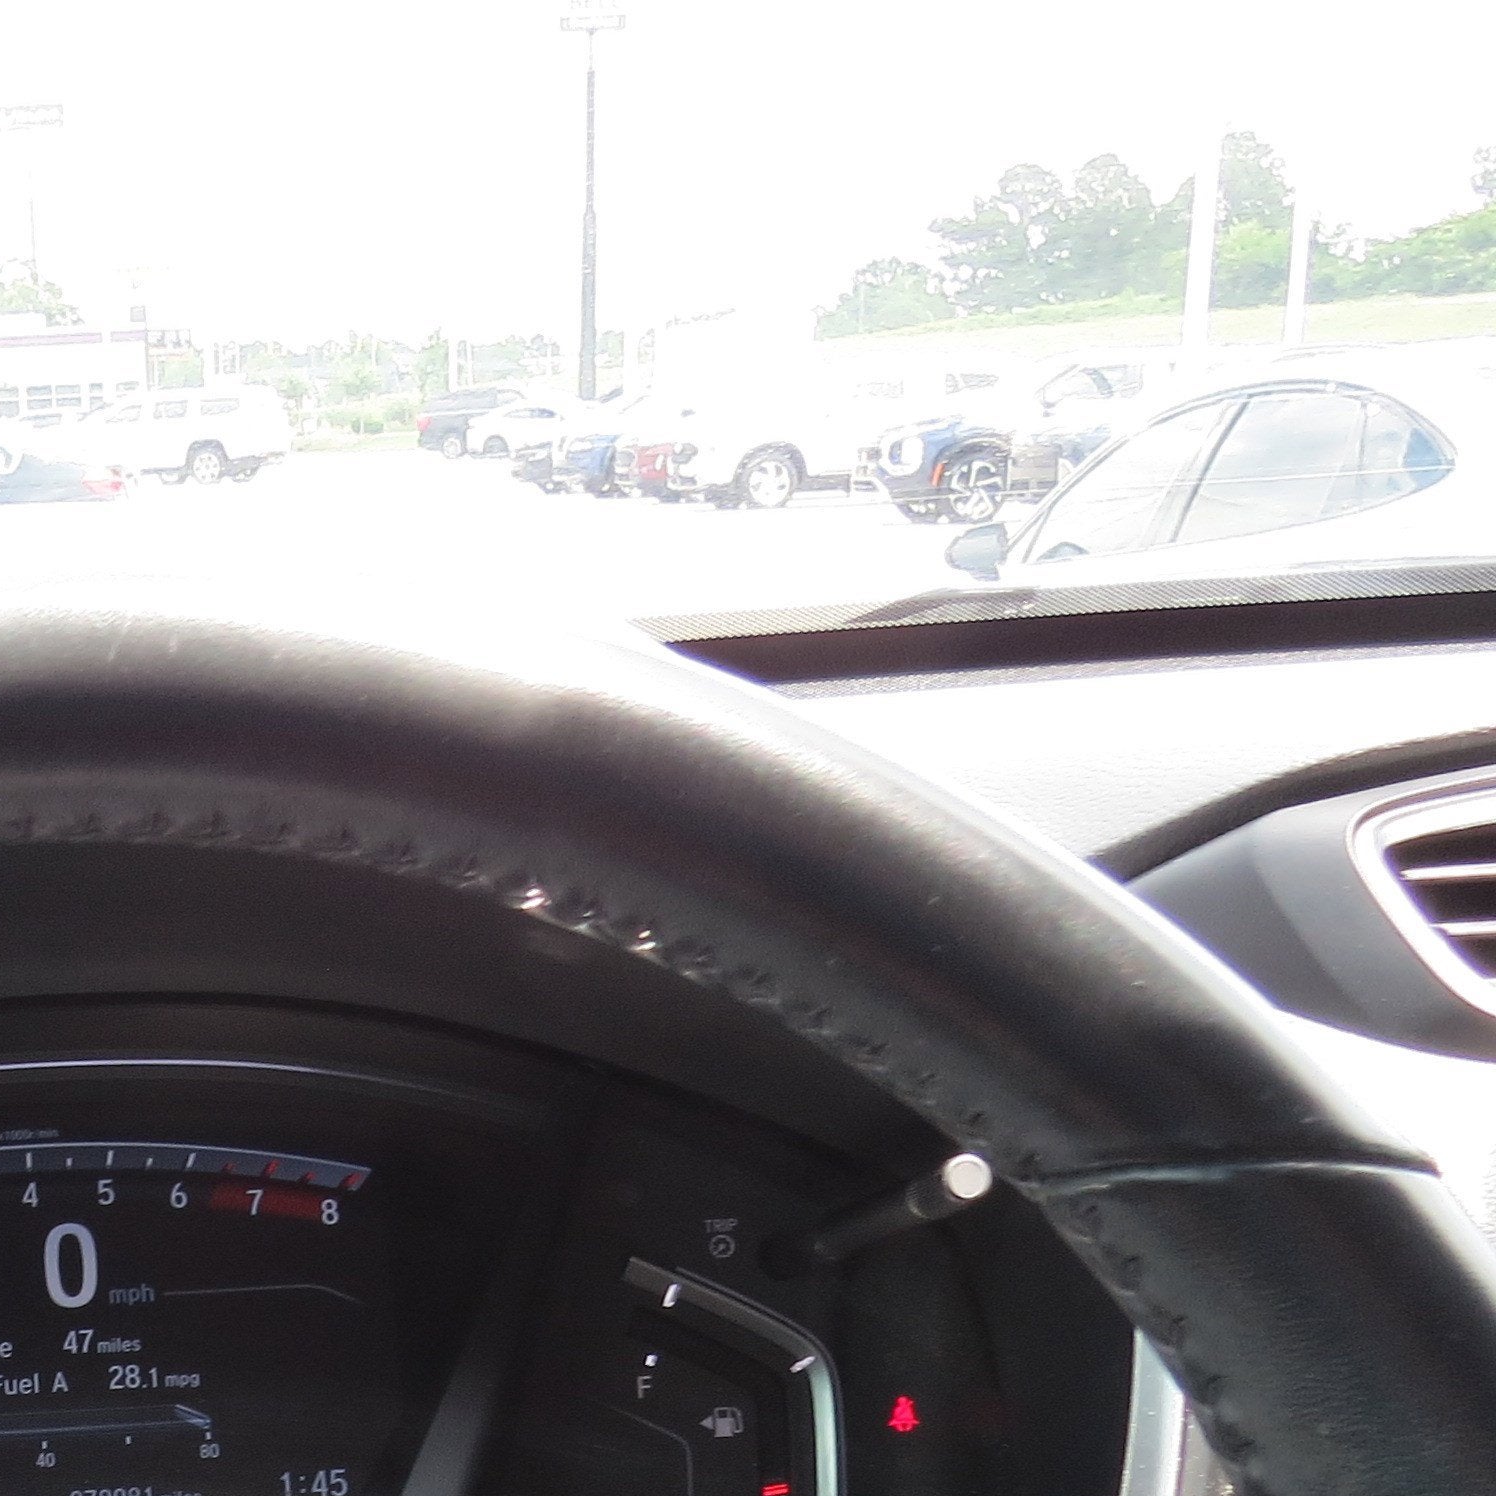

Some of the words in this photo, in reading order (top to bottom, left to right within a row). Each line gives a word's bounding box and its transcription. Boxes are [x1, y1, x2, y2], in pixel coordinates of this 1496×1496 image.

[22, 1181, 39, 1208] 4
[96, 1179, 115, 1206] 5
[169, 1182, 188, 1209] 6
[245, 1189, 264, 1216] 7
[320, 1198, 339, 1226] 8
[704, 1218, 738, 1233] TRIP
[43, 1223, 98, 1309] 0
[108, 1284, 155, 1306] mph
[63, 1329, 94, 1354] 47
[96, 1338, 142, 1354] miles
[51, 1371, 69, 1393] A
[108, 1364, 158, 1390] 28.1
[164, 1370, 201, 1388] mpg
[637, 1375, 653, 1399] F
[35, 1451, 56, 1468] 40
[199, 1444, 220, 1459] 80
